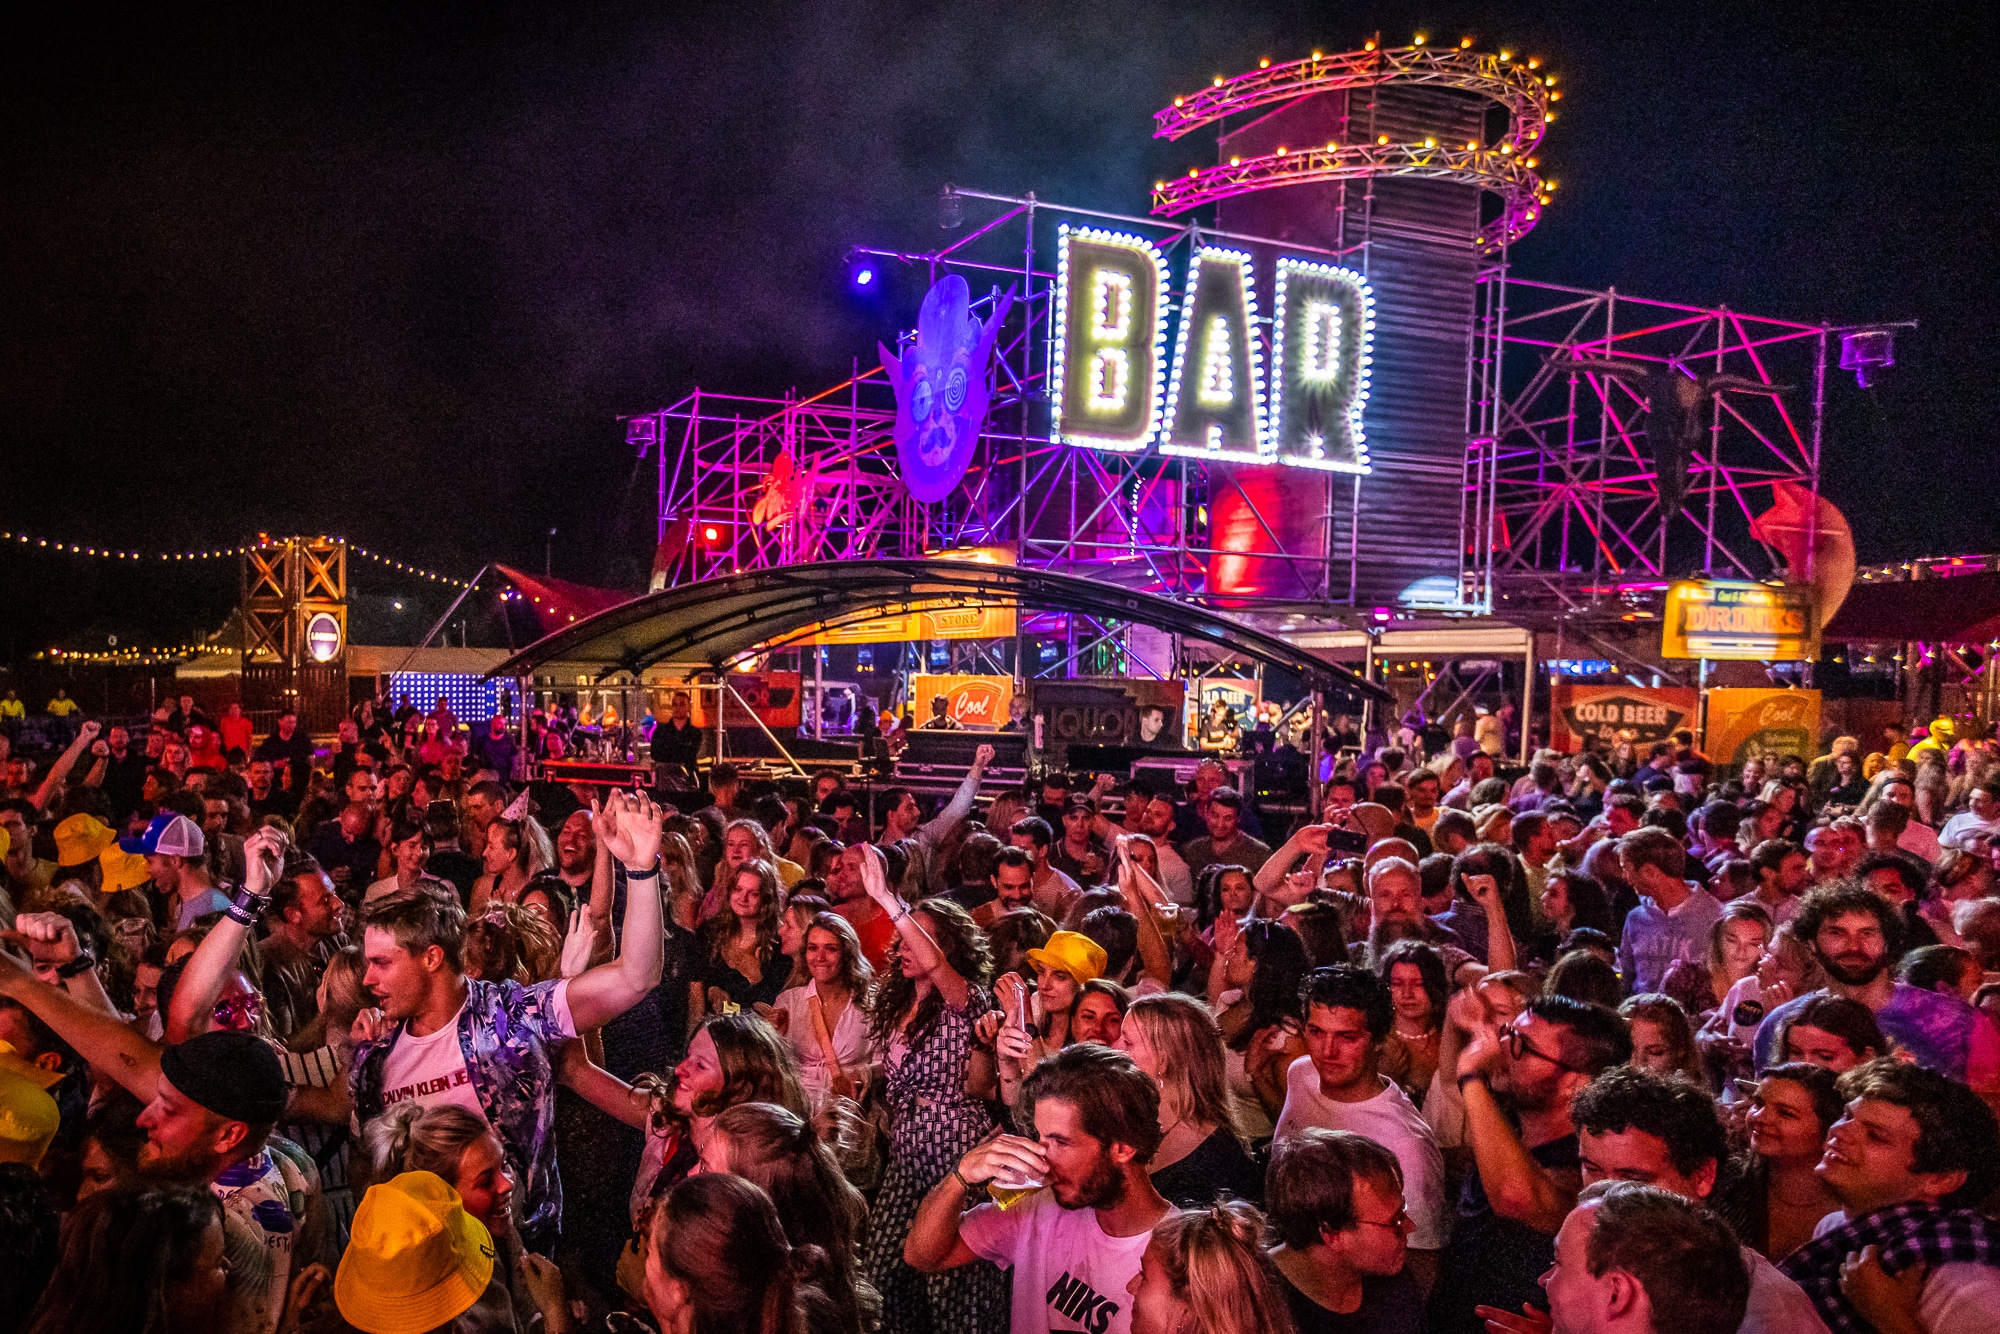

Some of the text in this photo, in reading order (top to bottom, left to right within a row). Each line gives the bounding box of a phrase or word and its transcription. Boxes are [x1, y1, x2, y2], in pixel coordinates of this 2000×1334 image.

[1050, 222, 1376, 475] BAR
[941, 614, 978, 625] STORE
[1685, 606, 1804, 634] DRINKS
[955, 691, 989, 717] Cool
[1202, 690, 1246, 705] OLD BEER
[1040, 705, 1137, 739] IQUOR
[1575, 704, 1668, 726] COLD BEER
[383, 1070, 470, 1105] CALVIN KLEIN JE
[1046, 1270, 1120, 1334] NIKS
